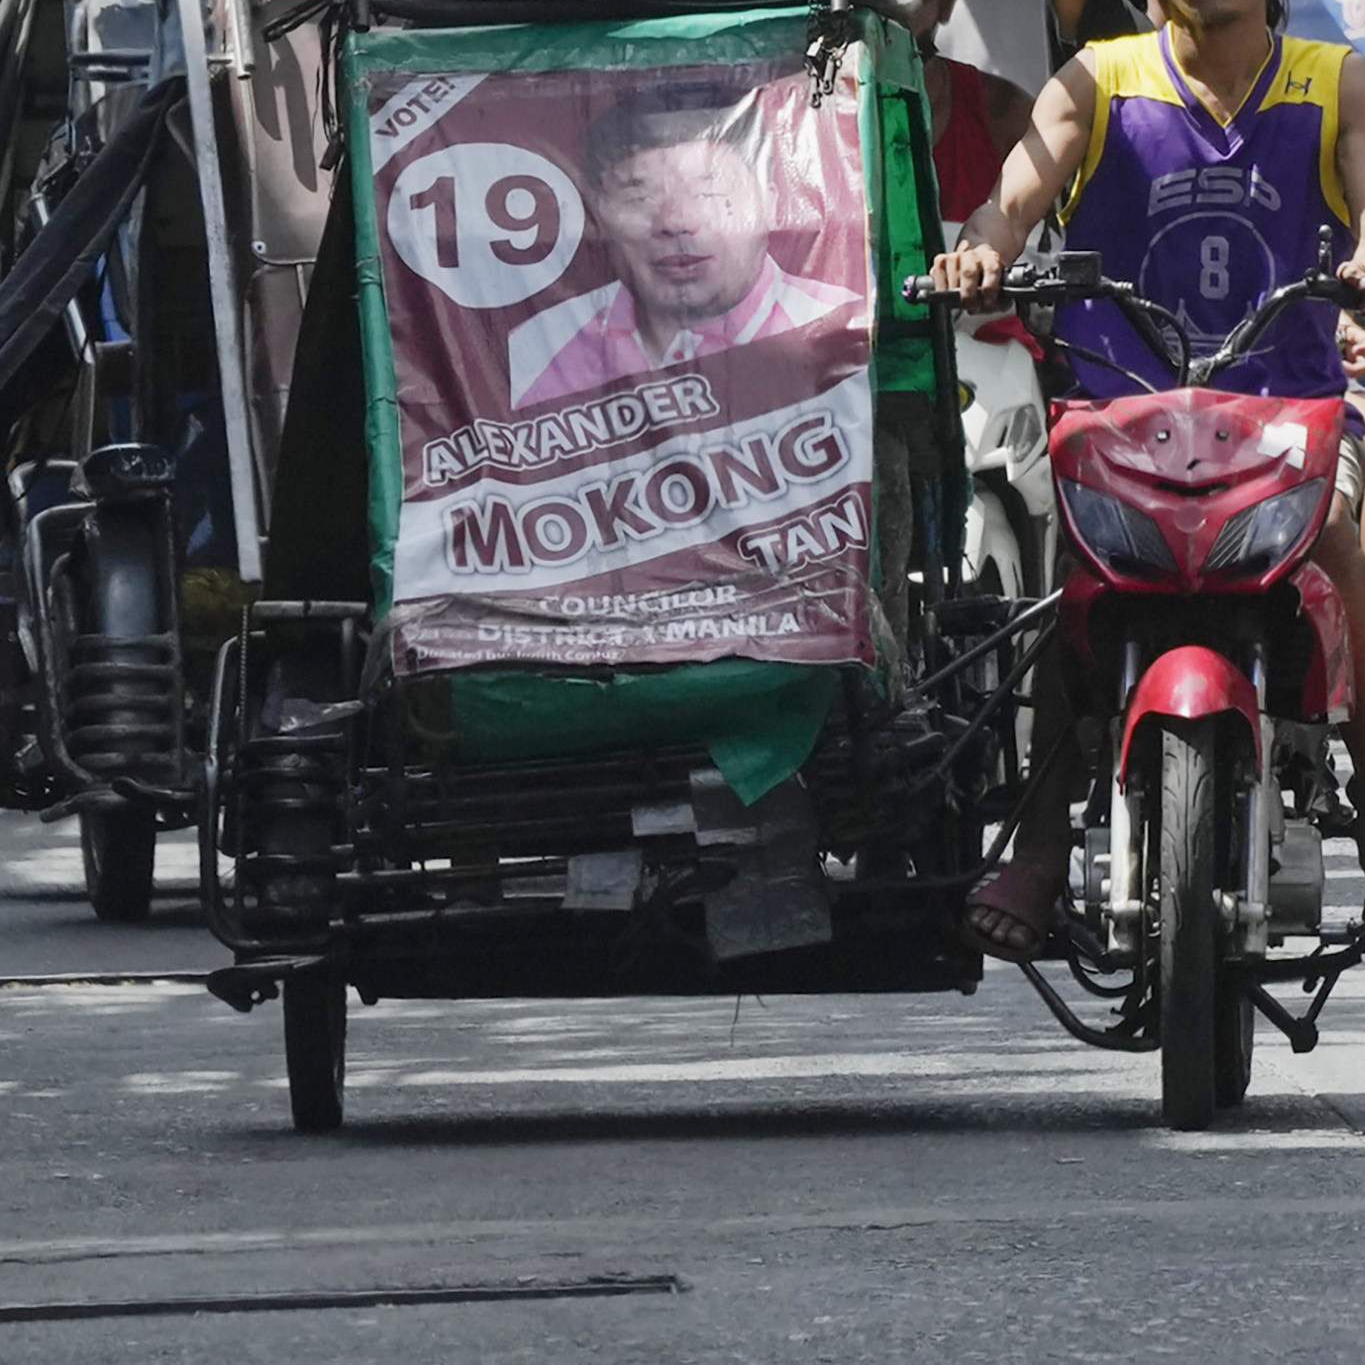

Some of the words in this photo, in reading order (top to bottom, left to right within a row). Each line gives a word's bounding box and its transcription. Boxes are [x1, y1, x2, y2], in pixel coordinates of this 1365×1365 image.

[374, 75, 461, 145] VOTE!
[408, 172, 564, 270] 19
[1146, 166, 1284, 218] ESP
[1199, 235, 1231, 302] 8
[424, 375, 718, 485] ALEXANDER
[448, 411, 848, 577] MOKONG
[740, 493, 868, 572] TAN
[476, 621, 626, 646] DISTRICT
[662, 611, 801, 643] MANILA
[537, 584, 739, 618] COUNCILOR
